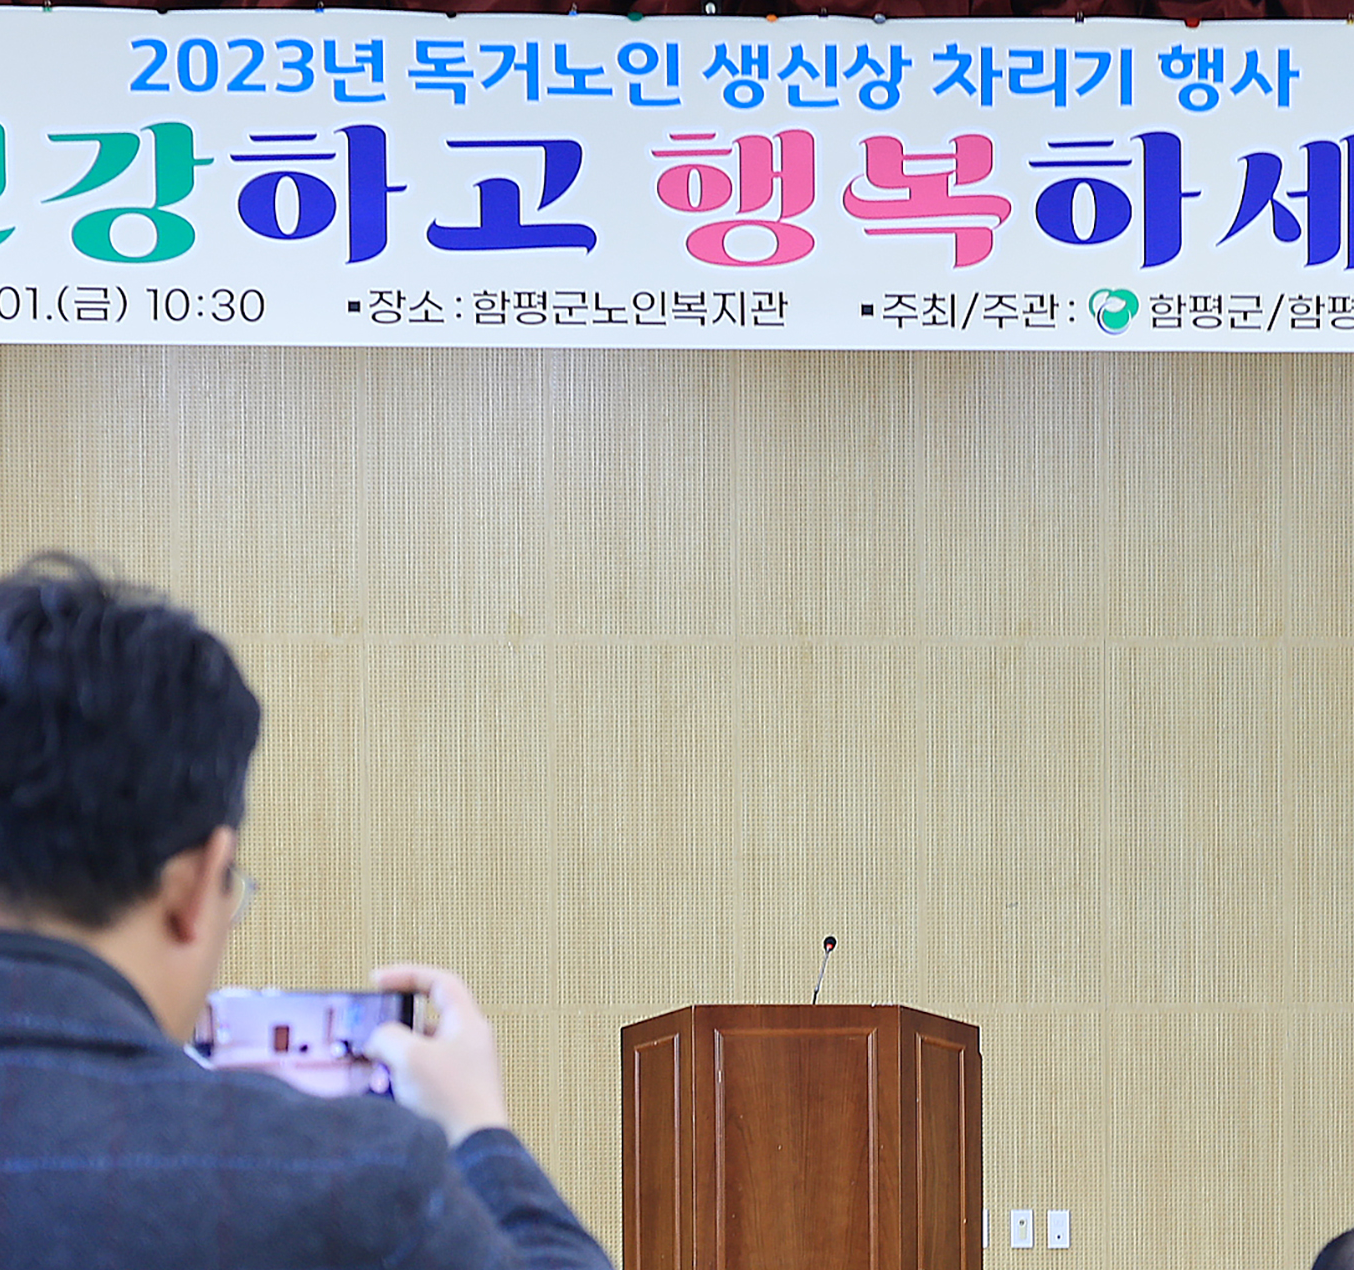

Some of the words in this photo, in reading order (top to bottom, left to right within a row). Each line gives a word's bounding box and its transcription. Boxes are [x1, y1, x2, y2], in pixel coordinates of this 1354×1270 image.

[130, 38, 387, 103] 2023년
[407, 39, 683, 107] 독거노인
[702, 42, 913, 111] 생신상
[932, 42, 1133, 109] 차리기
[1157, 43, 1301, 113] 행사
[146, 288, 265, 323] 10:30
[473, 289, 790, 327] 함평군노인복지관
